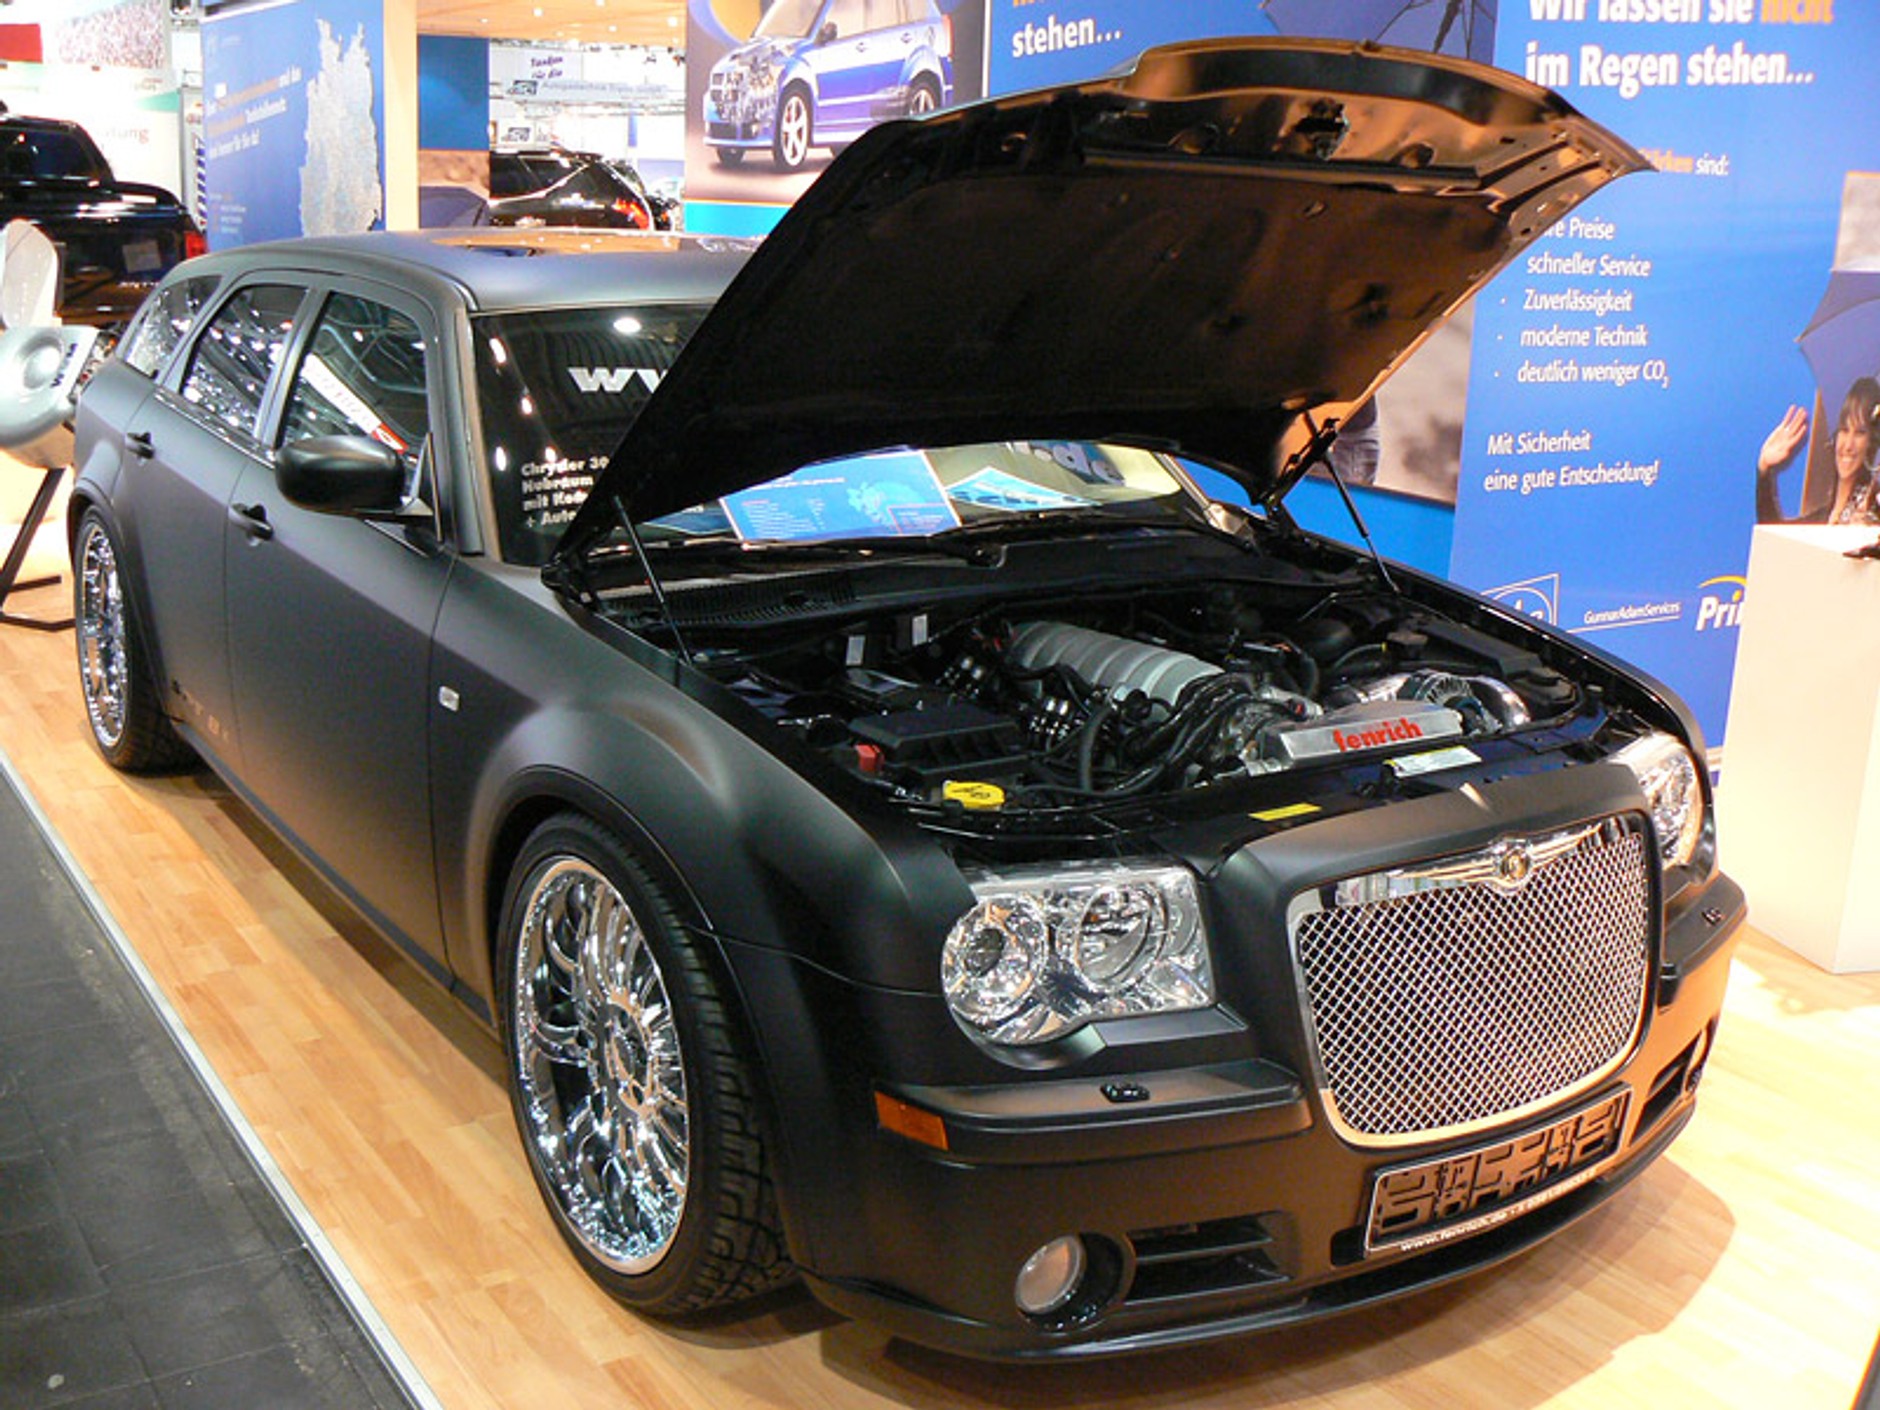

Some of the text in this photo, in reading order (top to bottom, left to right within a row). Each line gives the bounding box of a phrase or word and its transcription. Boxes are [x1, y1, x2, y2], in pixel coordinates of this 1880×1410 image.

[1597, 0, 1702, 23] lassen
[1012, 15, 1122, 57] stehen...
[1525, 40, 1815, 99] im Regen stehen...
[1568, 215, 1616, 241] Preise
[1526, 251, 1652, 277] schneller Service
[1523, 288, 1634, 317] Zuverlässigkeit
[1519, 324, 1649, 347] moderne Technik
[1516, 359, 1579, 383] deutlich
[1582, 360, 1641, 387] weniger
[1487, 428, 1593, 456] Mit Sicherheit
[1483, 459, 1661, 495] eine gute Entscheidung!
[1695, 589, 1744, 631] Pri
